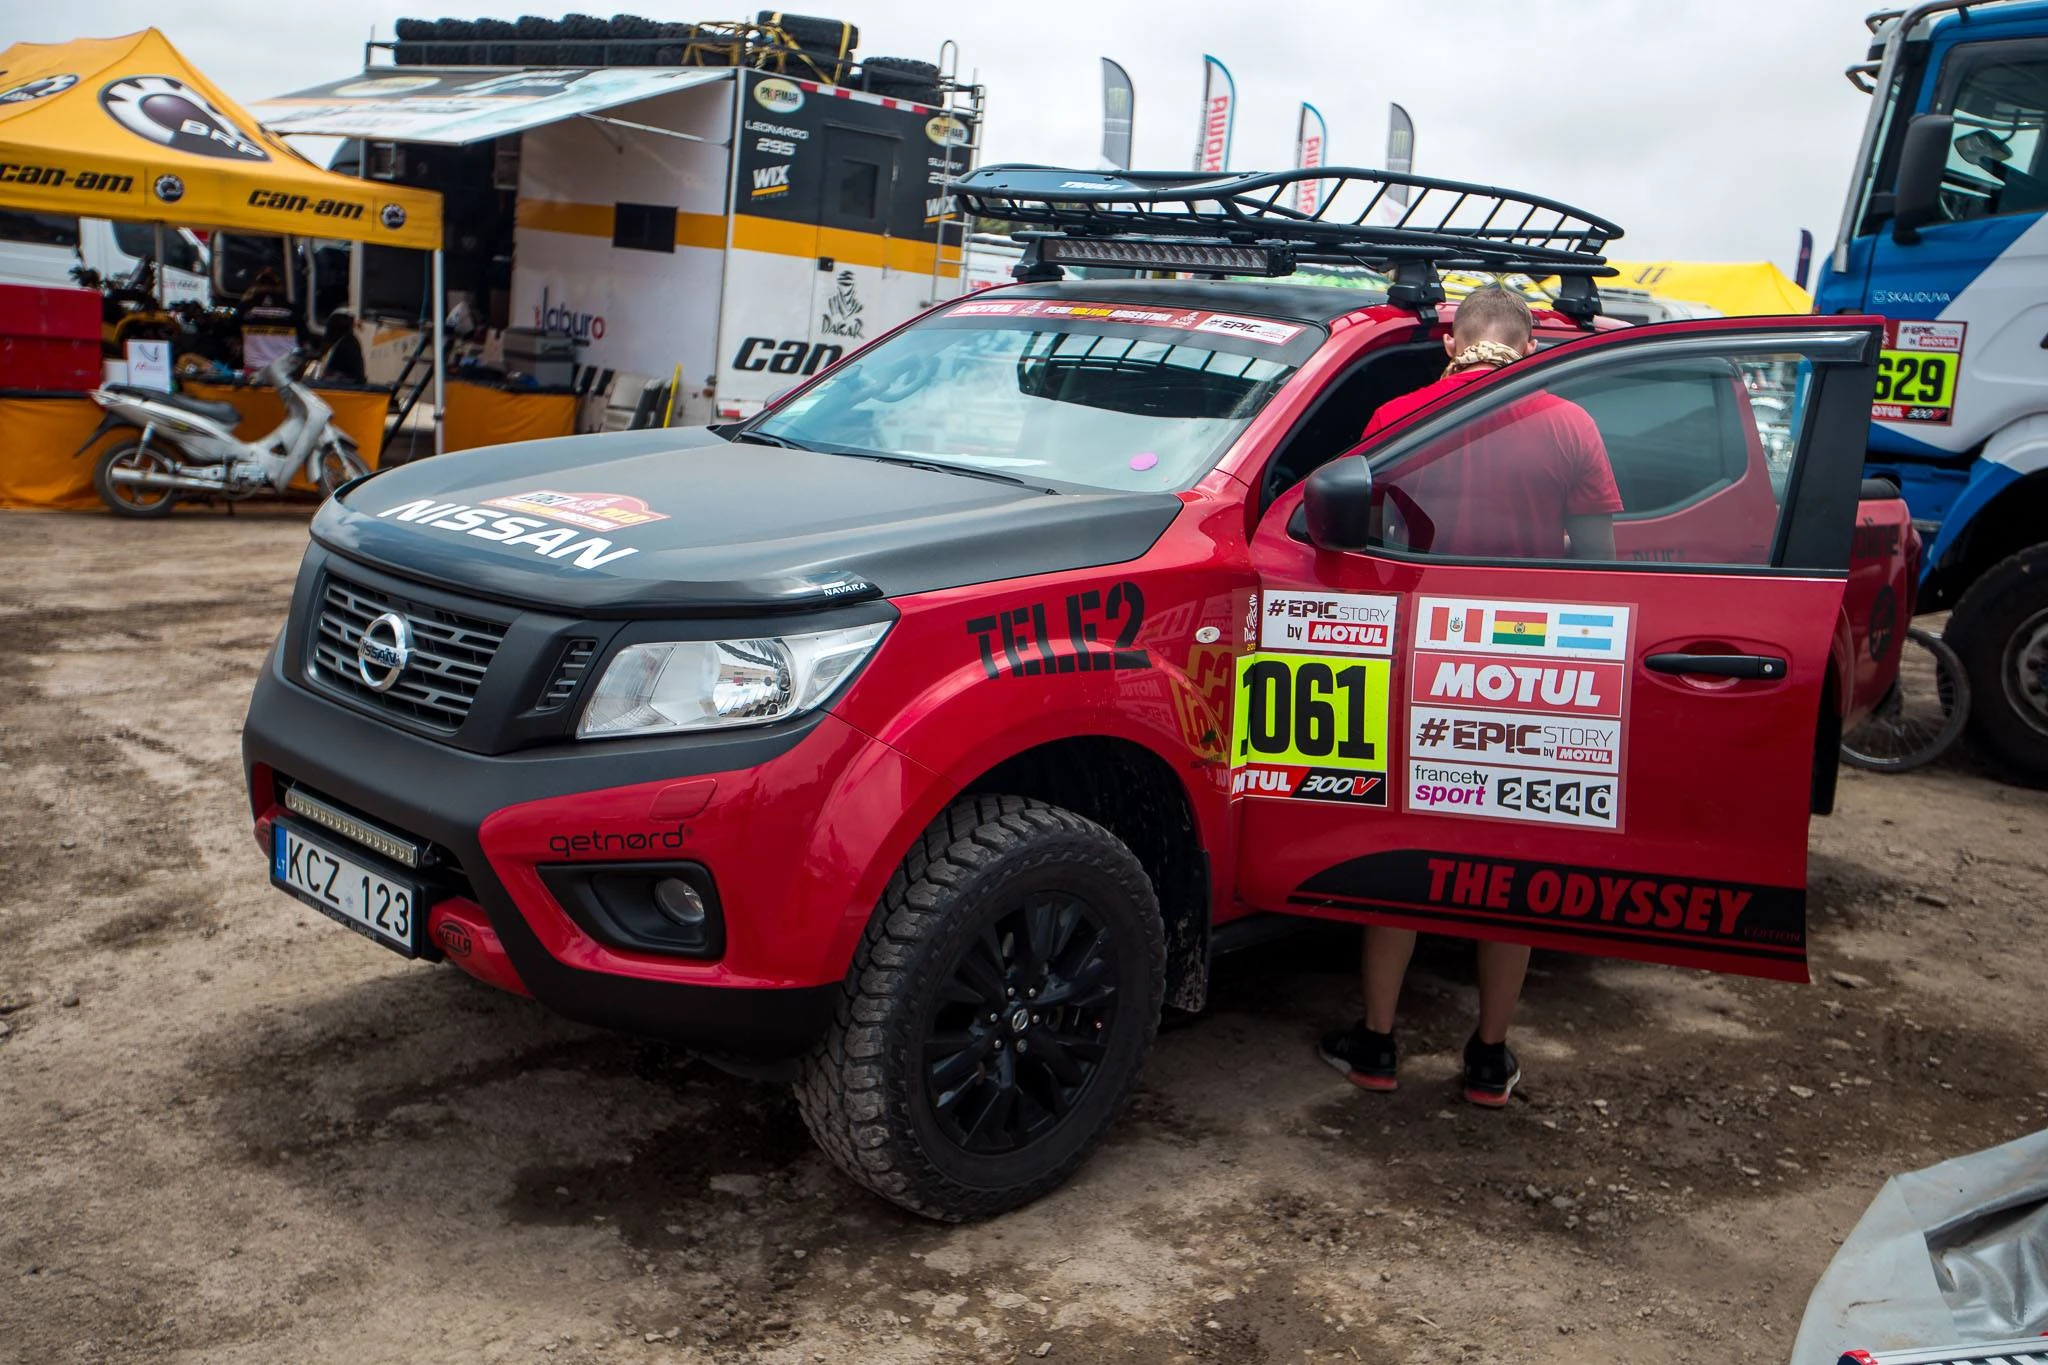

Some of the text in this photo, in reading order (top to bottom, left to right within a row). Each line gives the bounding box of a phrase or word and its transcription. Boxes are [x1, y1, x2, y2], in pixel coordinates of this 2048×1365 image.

[180, 118, 265, 157] BRP
[744, 120, 809, 139] LEONARDO
[756, 137, 797, 156] 295
[753, 164, 791, 189] WIX
[248, 188, 365, 220] can-am
[1873, 357, 1946, 402] 629
[377, 499, 639, 569] NISSAN
[823, 582, 868, 597] NAVARA
[966, 581, 1152, 680] TELE2
[1287, 624, 1384, 644] by MOTUL
[1429, 661, 1600, 707] MOTUL
[1543, 747, 1610, 763] by MOTUL
[1302, 775, 1381, 796] 300V
[1415, 765, 1488, 785] francetv
[1415, 783, 1486, 806] sport
[287, 836, 409, 938] KCZ 123
[1426, 857, 1754, 935] THE ODYSSEY
[1744, 926, 1801, 942] EDITION
